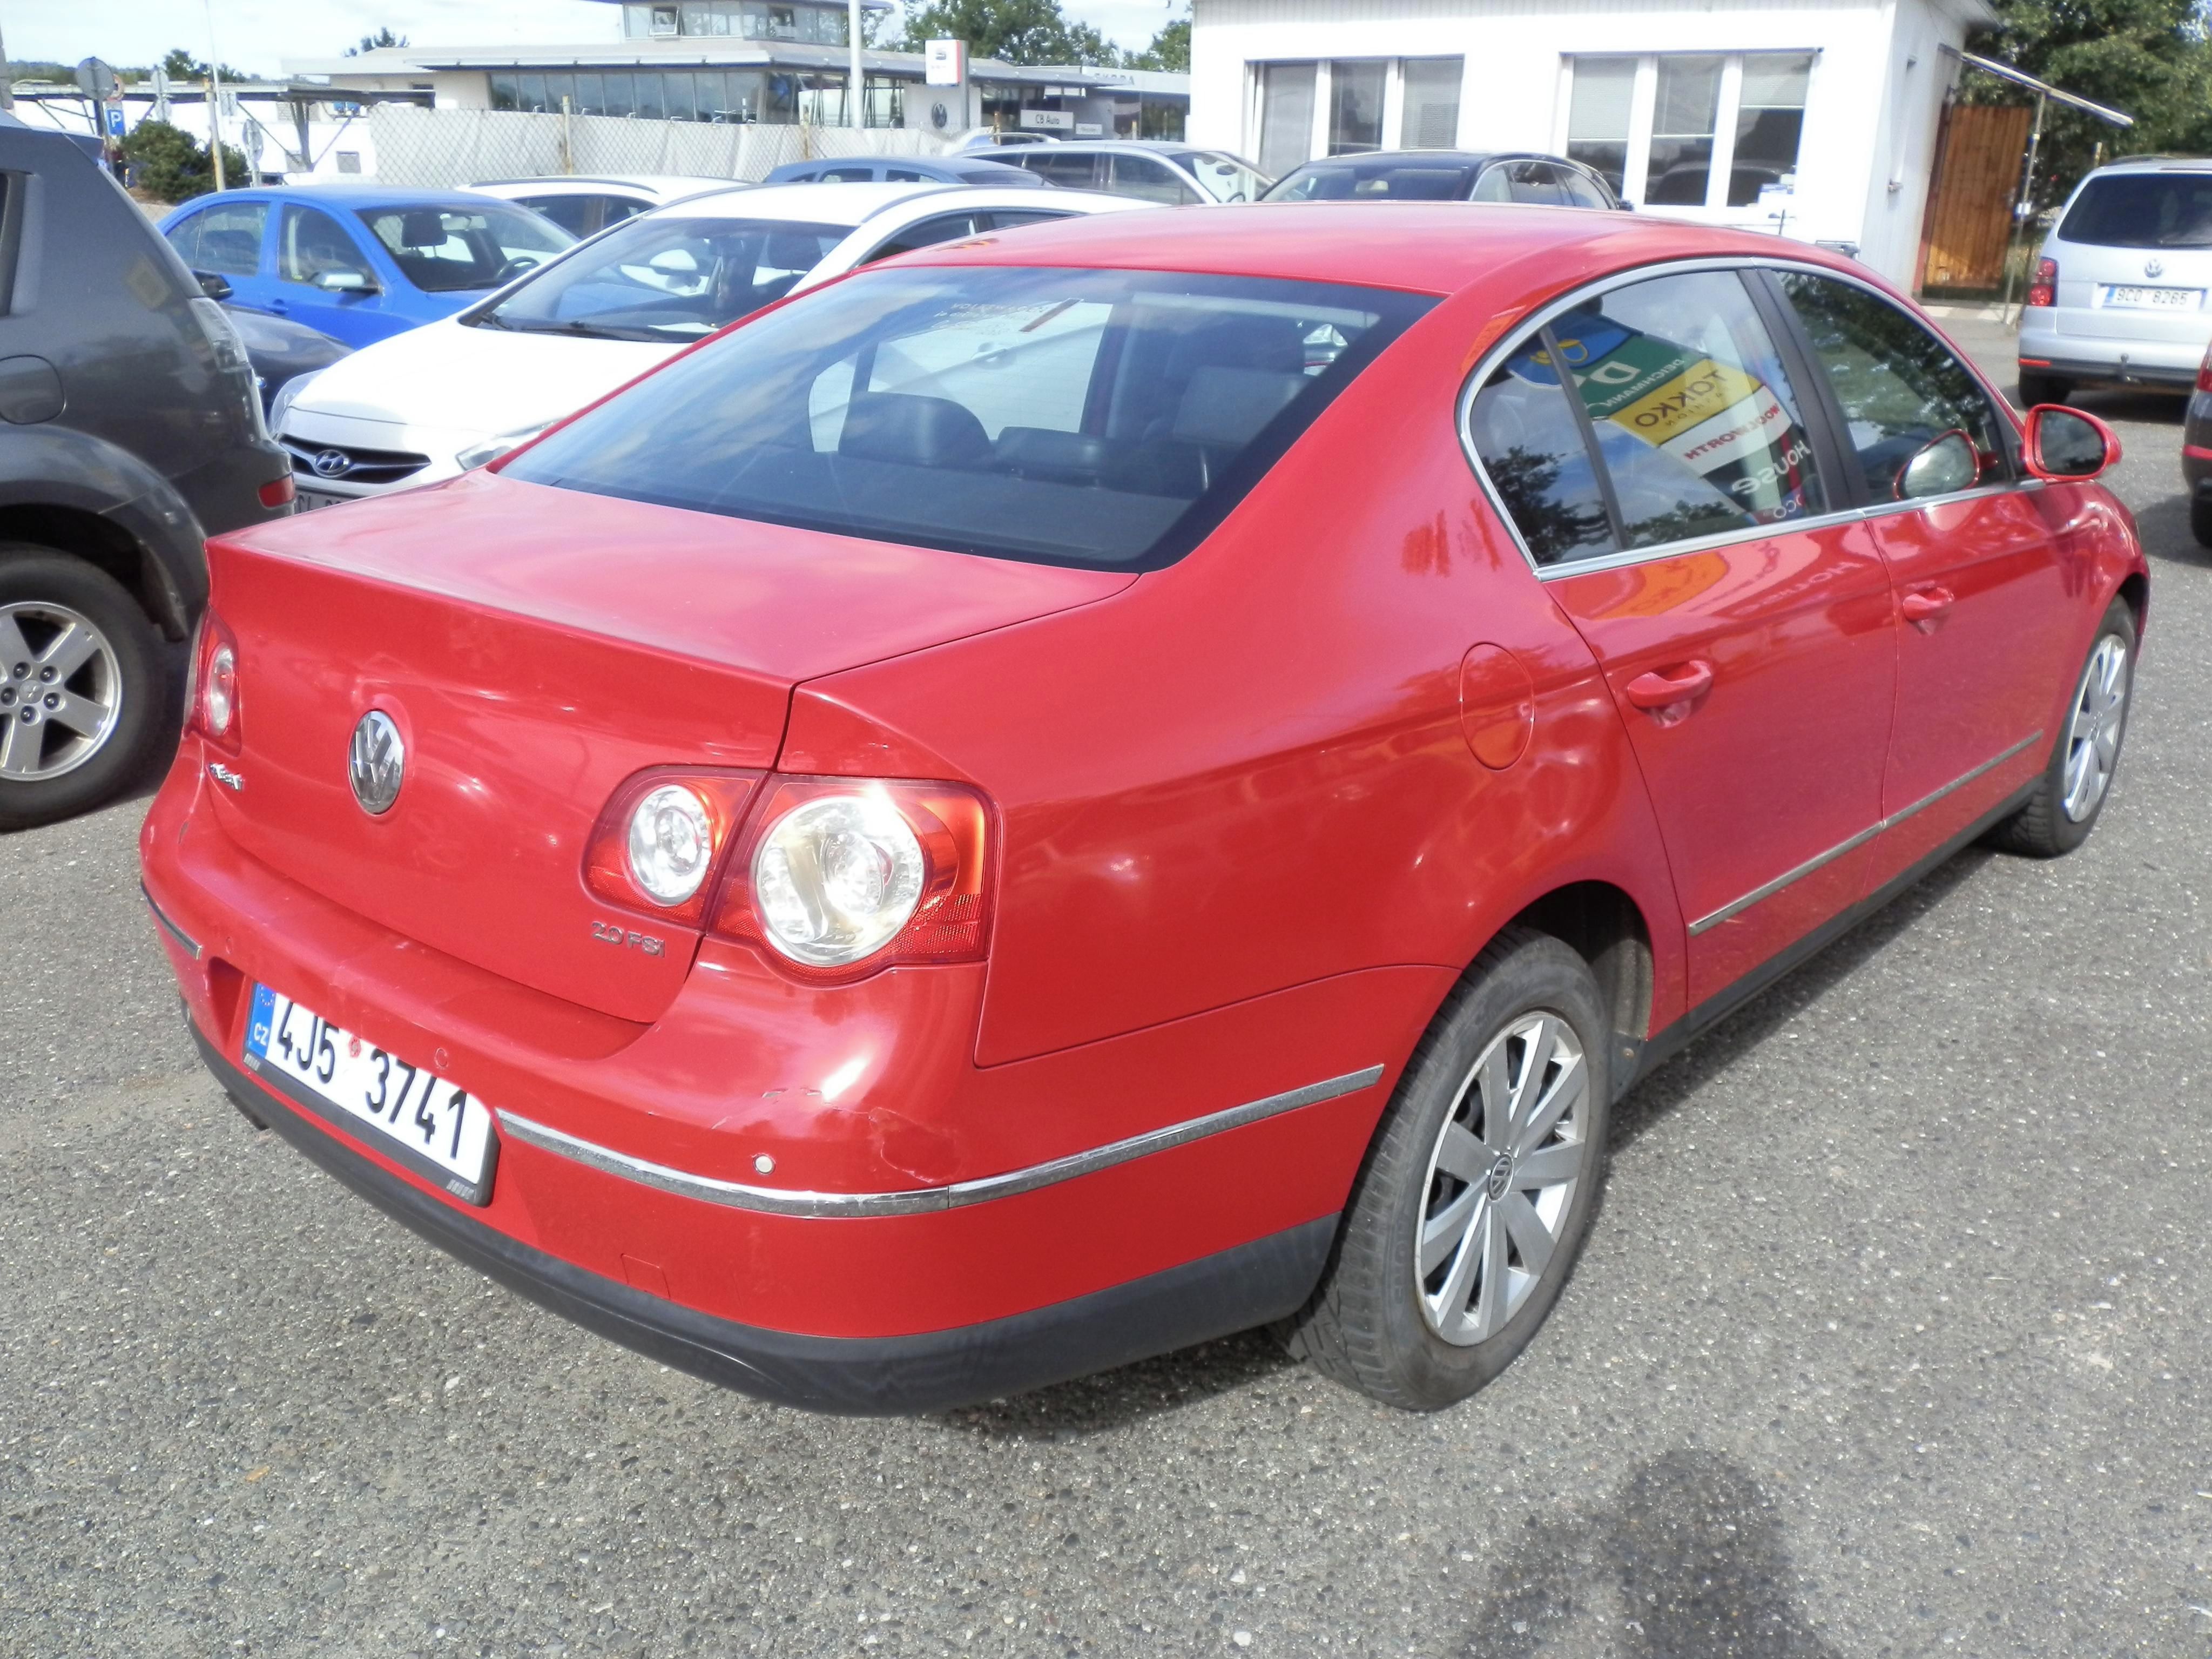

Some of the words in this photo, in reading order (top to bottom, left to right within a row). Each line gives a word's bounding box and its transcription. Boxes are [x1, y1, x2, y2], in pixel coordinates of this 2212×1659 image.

[110, 111, 122, 128] P
[1035, 113, 1044, 124] CB
[2152, 291, 2189, 305] 8265
[627, 930, 666, 959] FSI
[253, 1021, 269, 1047] CZ
[277, 1001, 340, 1084] 4J5
[365, 1047, 468, 1160] 3741
